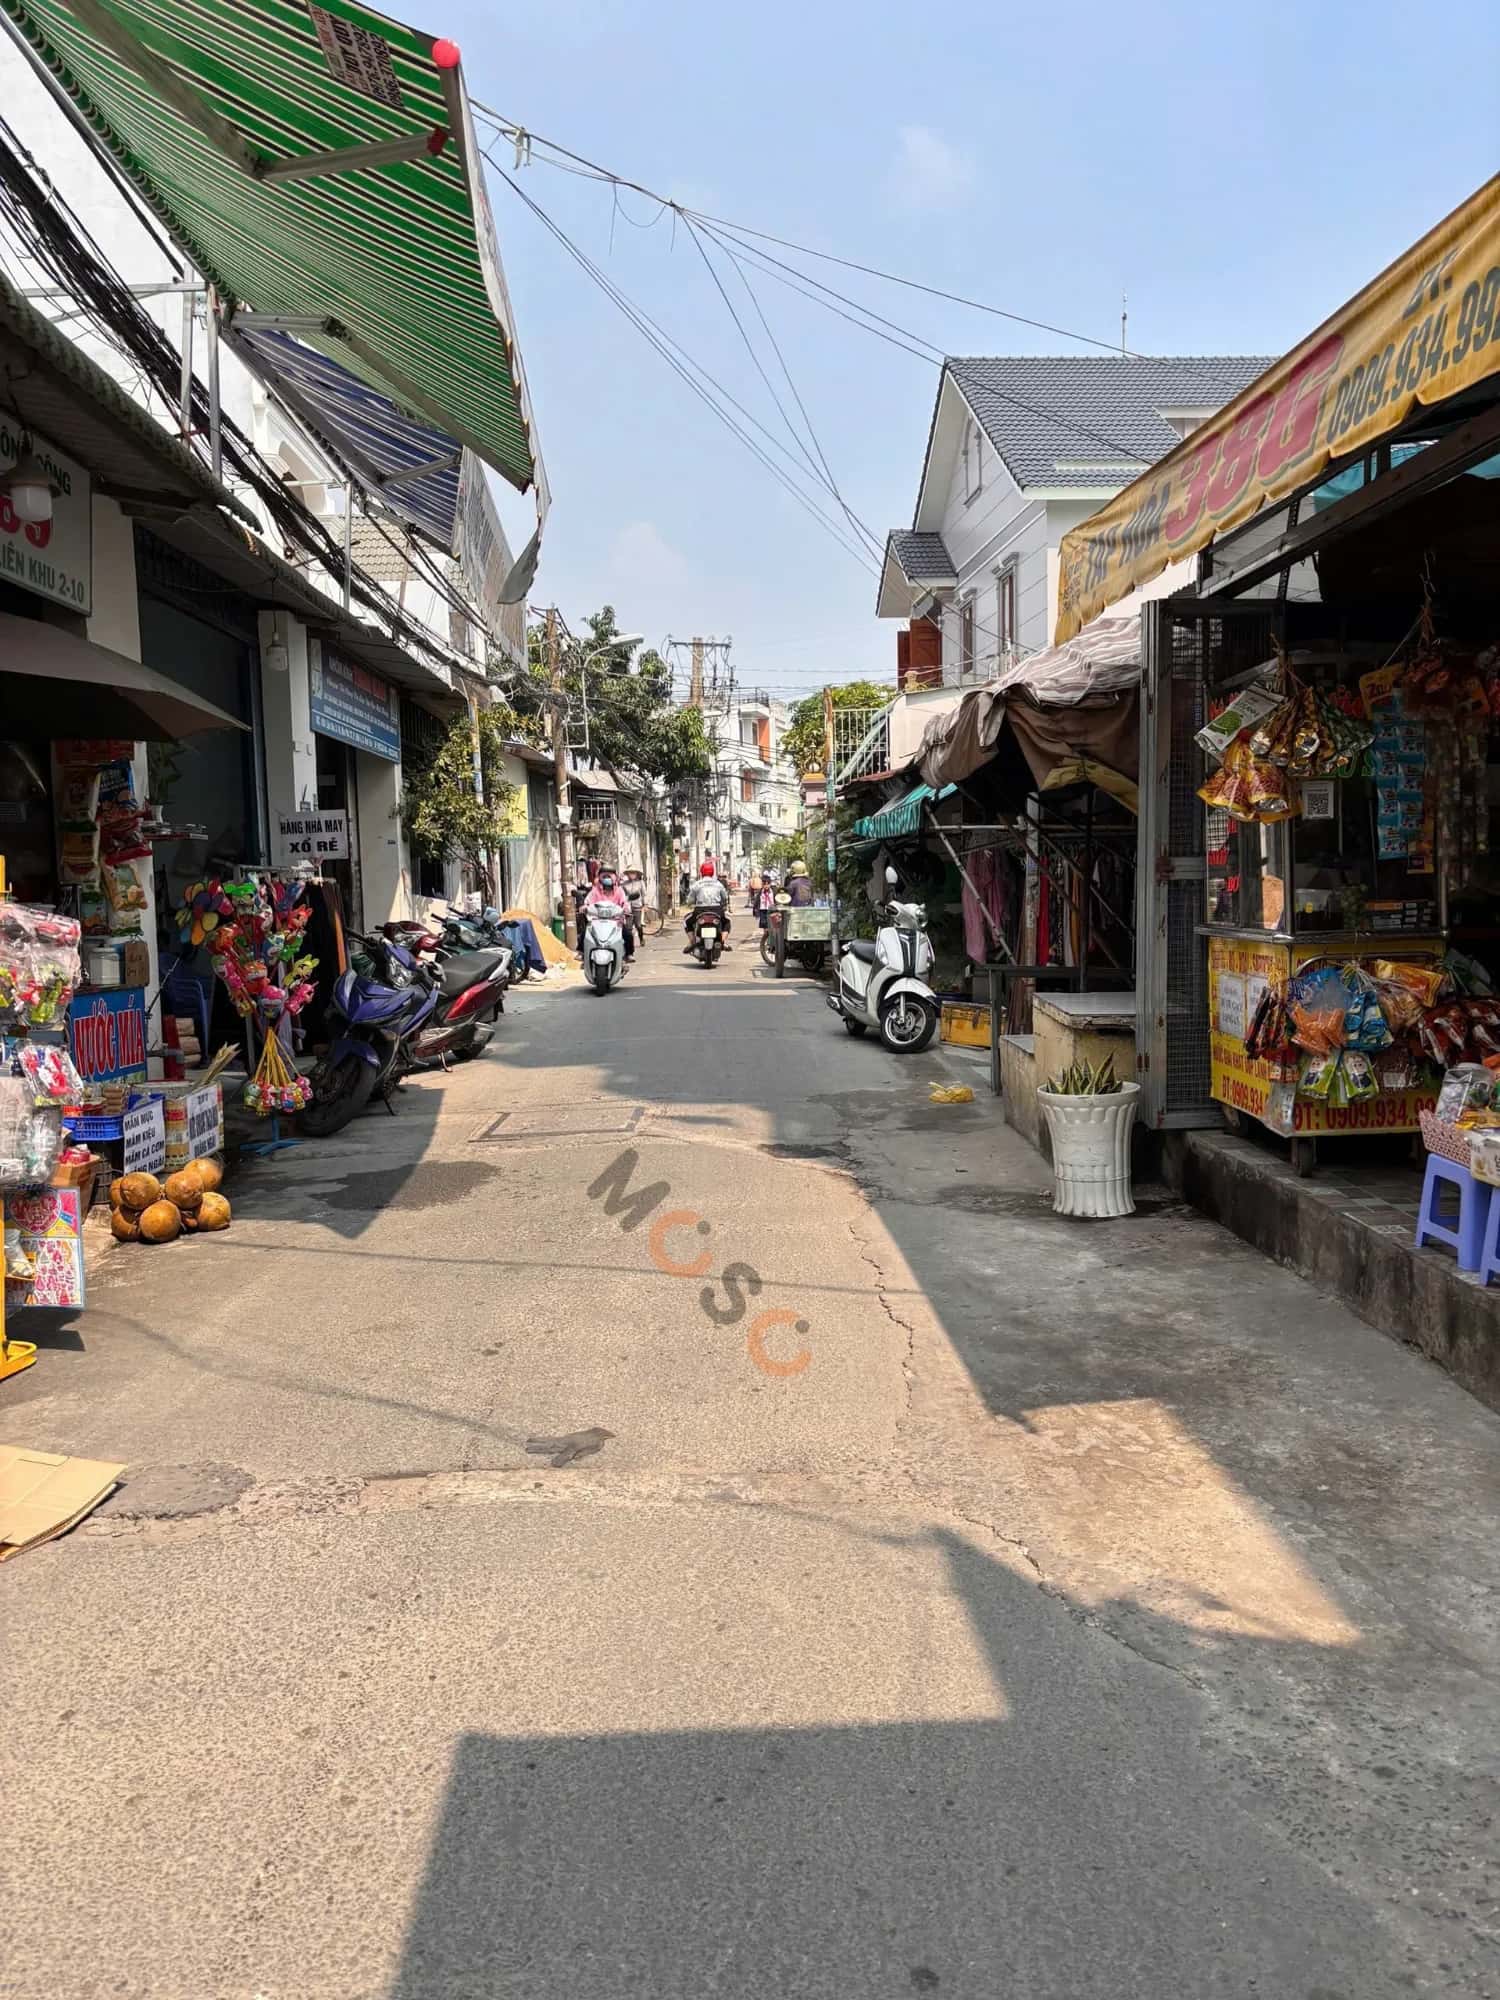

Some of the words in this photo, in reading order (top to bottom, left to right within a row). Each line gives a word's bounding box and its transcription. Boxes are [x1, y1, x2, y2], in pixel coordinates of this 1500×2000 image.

[1165, 334, 1346, 548] 38G
[29, 557, 55, 590] KHU
[59, 573, 84, 603] 2-10
[324, 819, 343, 833] MAY
[74, 997, 116, 1079] NƯỚC
[116, 993, 145, 1069] MÍA
[1293, 1102, 1321, 1130] ĐT:
[1326, 1098, 1436, 1129] 0909.934.99
